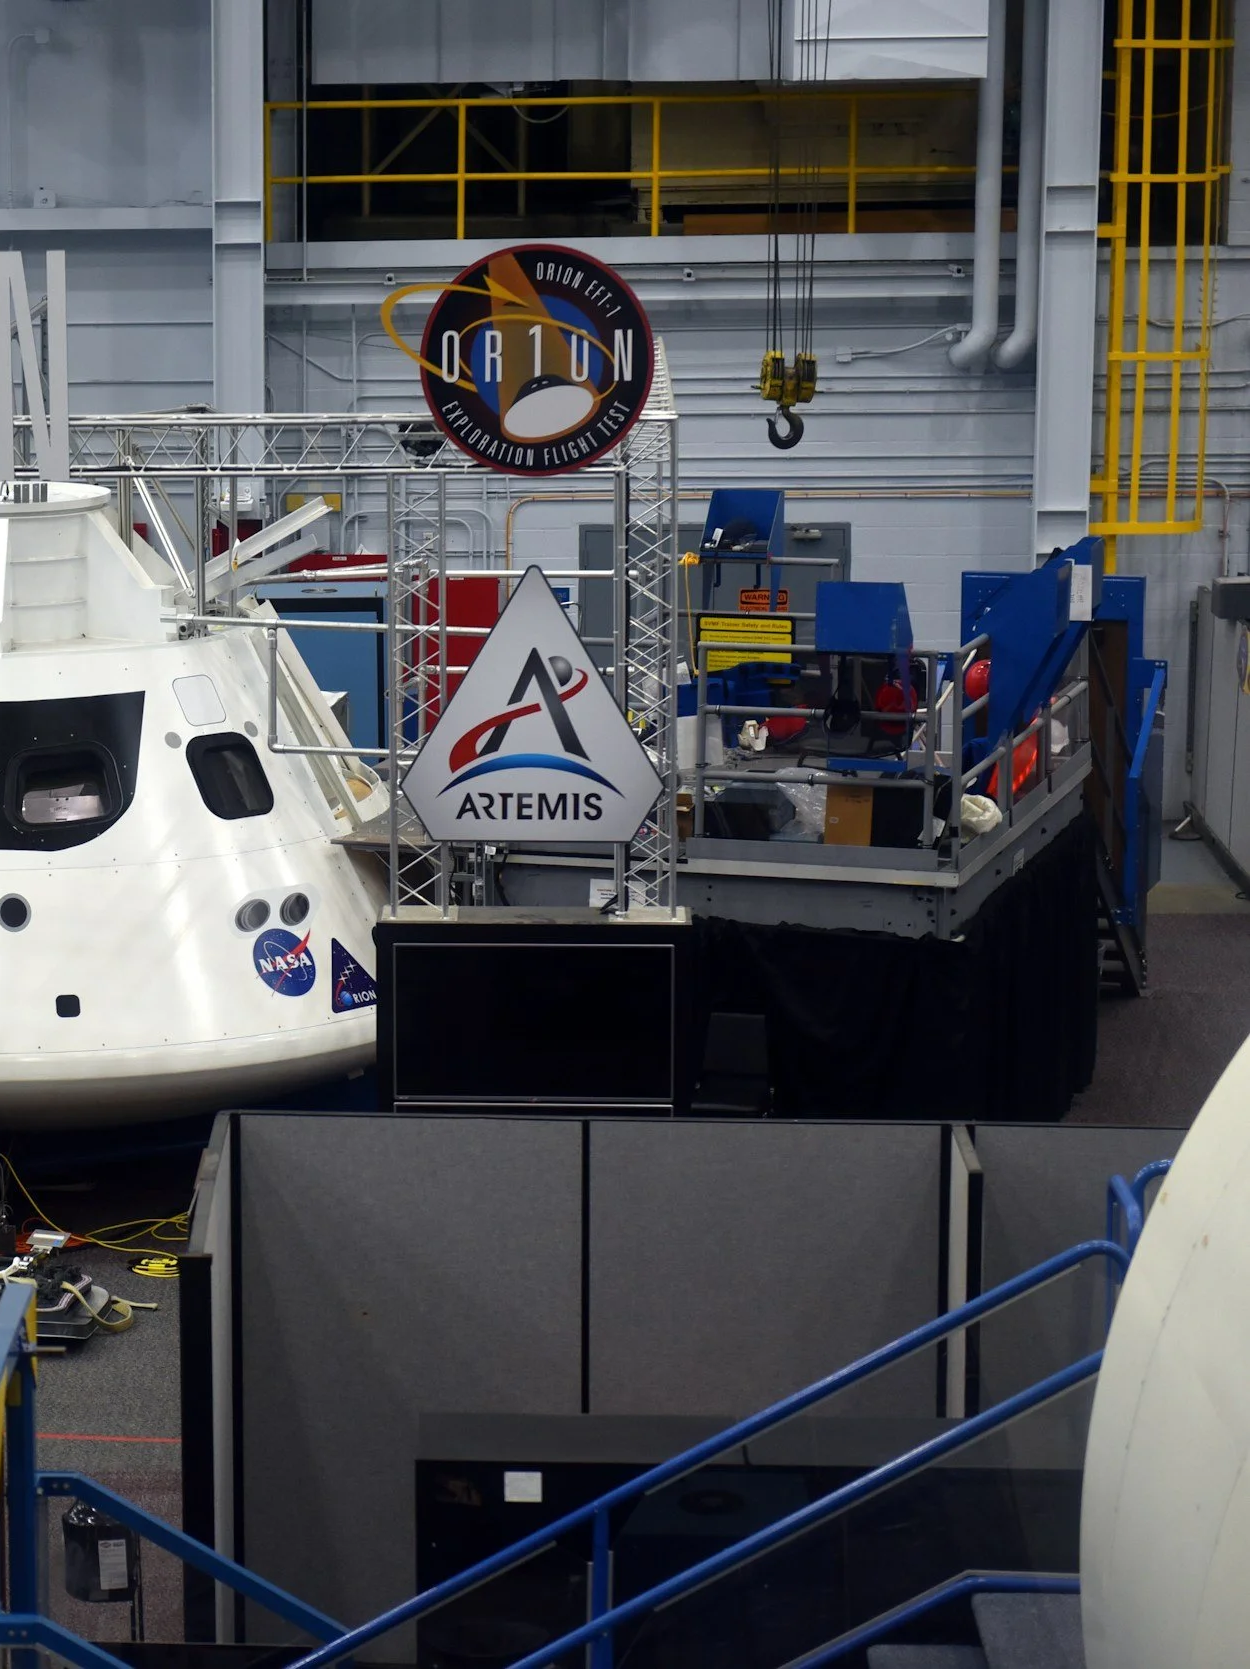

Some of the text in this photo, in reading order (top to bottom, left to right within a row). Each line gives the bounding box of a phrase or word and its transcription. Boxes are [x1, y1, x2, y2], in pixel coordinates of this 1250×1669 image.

[536, 261, 622, 318] ORION EFT-1
[441, 400, 631, 467] EXPLORATION FLIGHT TEST
[744, 593, 785, 601] WARNG
[455, 792, 603, 821] ARTEMIS
[258, 952, 312, 974] NASA
